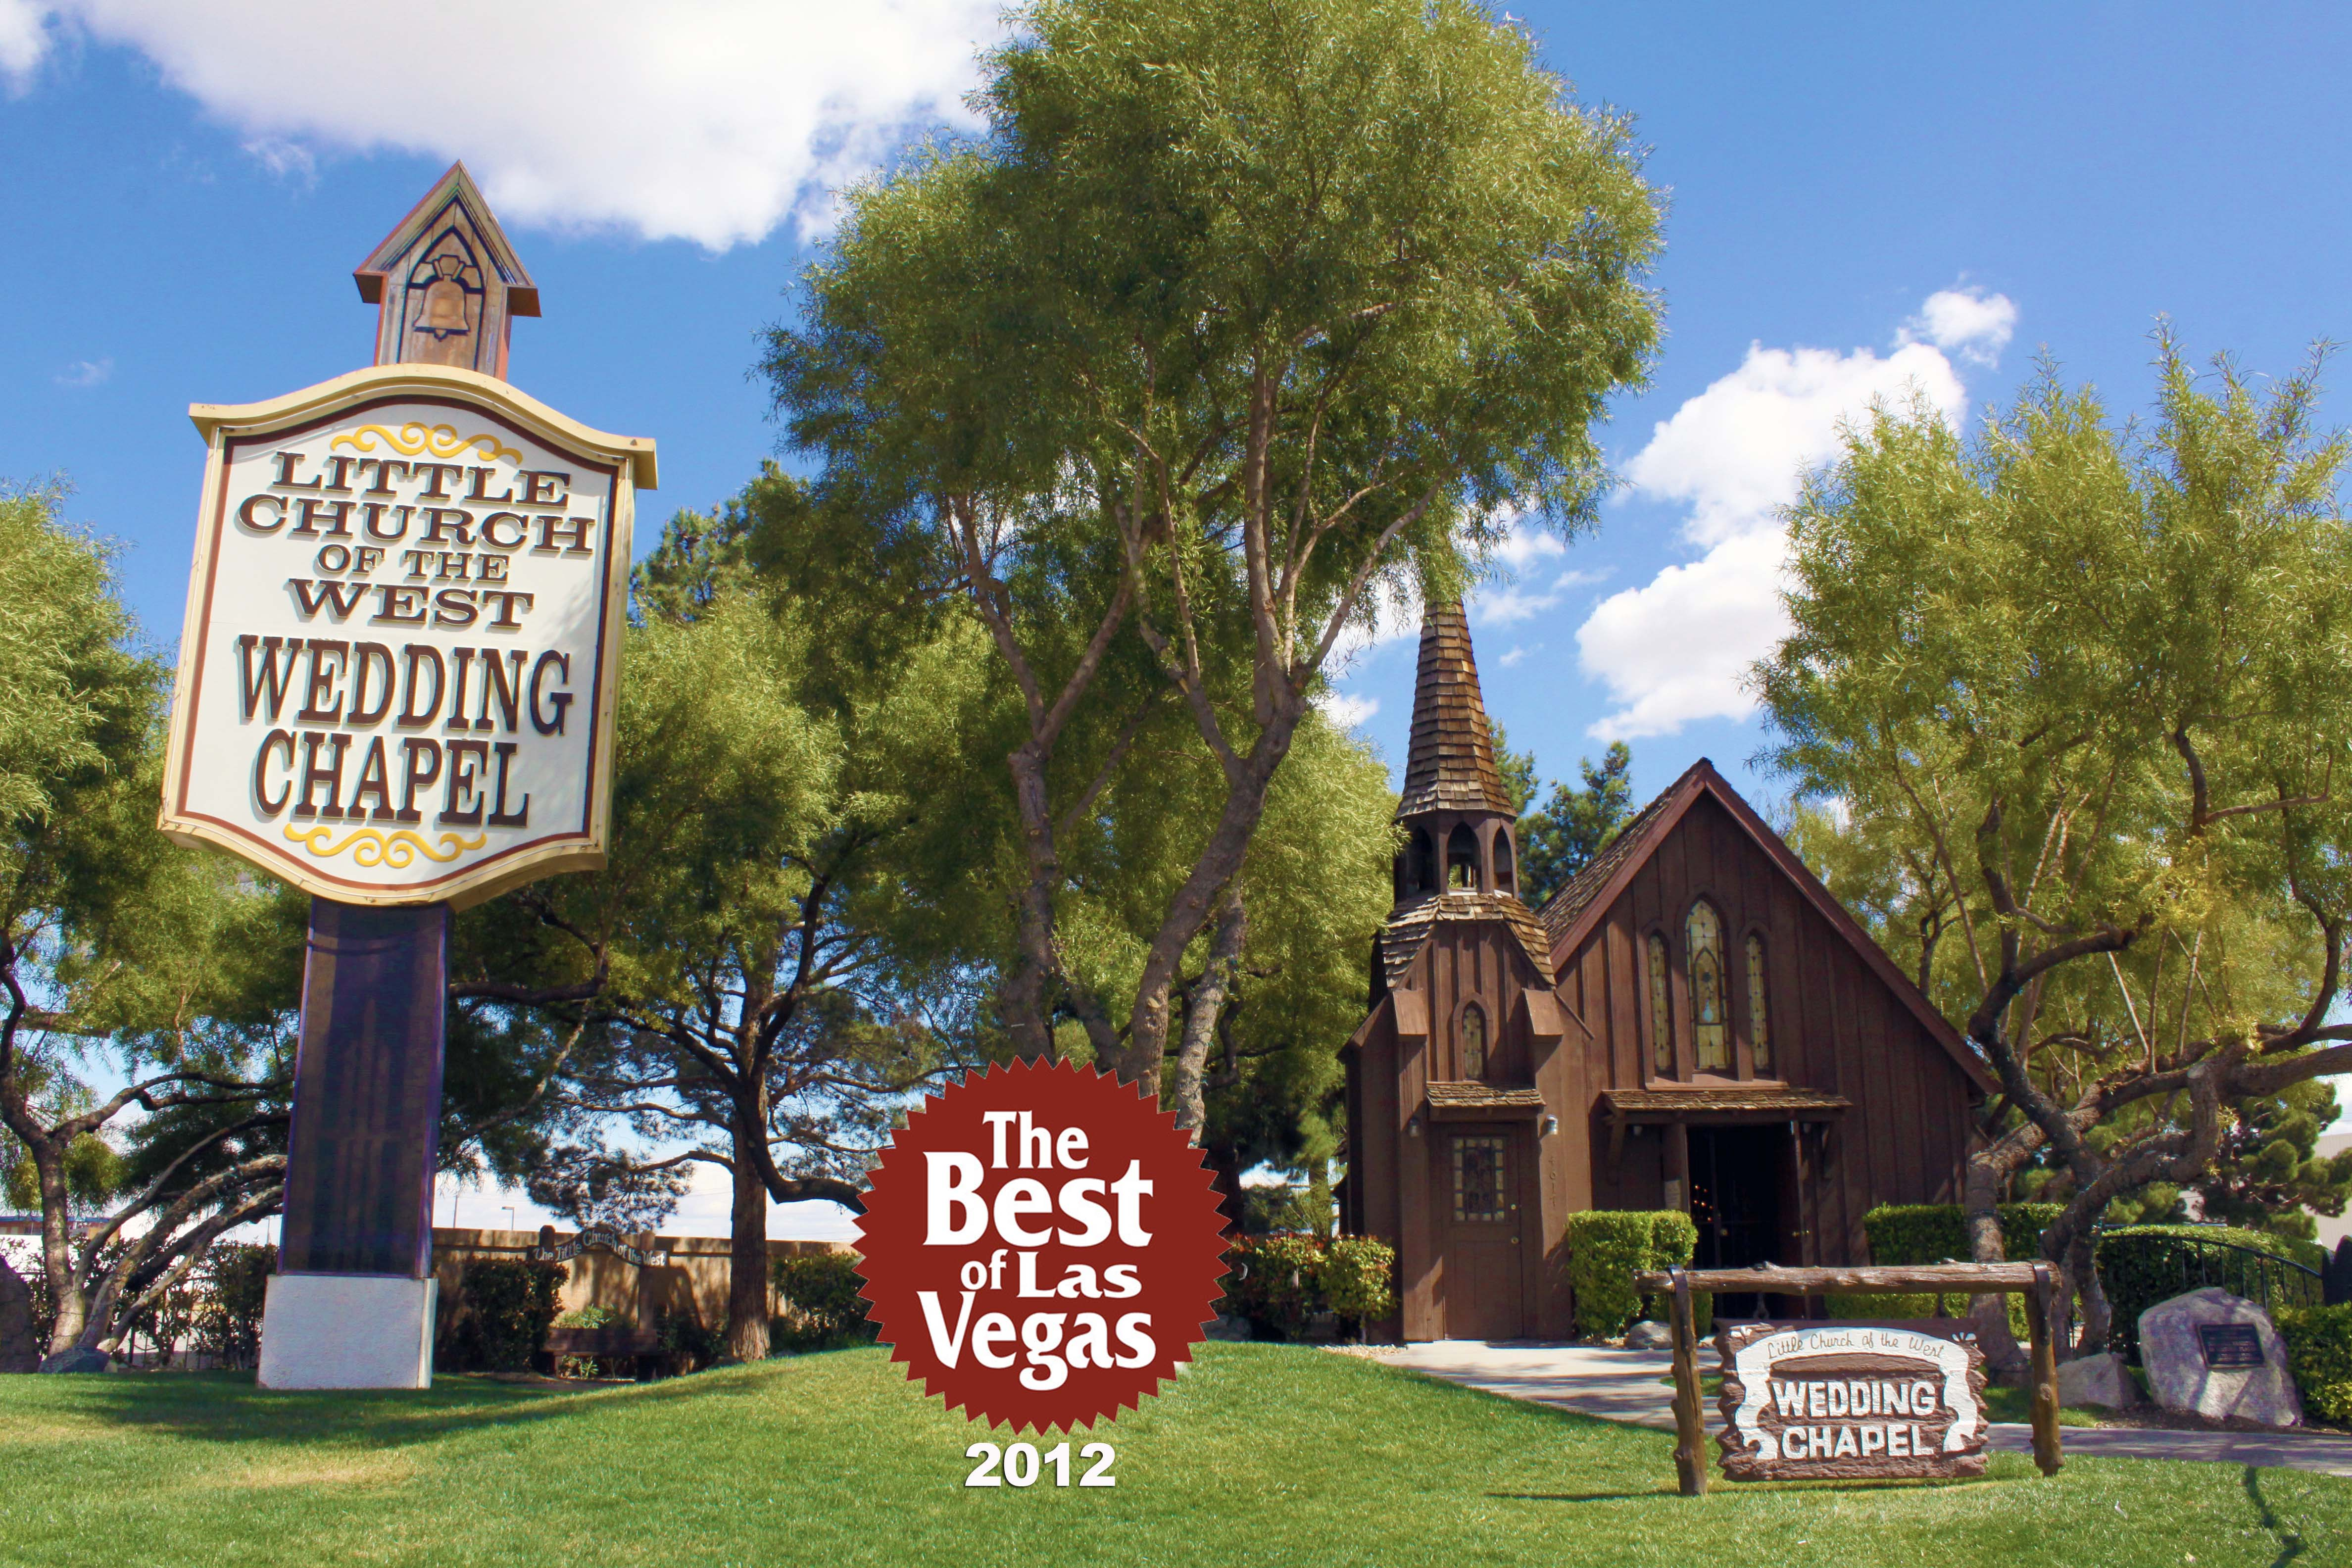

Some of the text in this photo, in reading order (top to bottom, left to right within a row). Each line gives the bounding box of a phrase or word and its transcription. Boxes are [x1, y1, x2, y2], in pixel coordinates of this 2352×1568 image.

[273, 451, 572, 508] LITTLE
[238, 494, 595, 554] CHURCH
[317, 544, 510, 583] OF THE
[289, 578, 535, 630] WEST
[238, 634, 573, 736] WEDDING
[253, 728, 530, 827] CHAPEL
[583, 1230, 617, 1253] Church
[617, 1244, 628, 1259] of
[628, 1248, 642, 1265] the
[642, 1250, 666, 1266] West
[1767, 1332, 1945, 1359] Little Church of the West
[1772, 1381, 1936, 1417] WEDDING
[1782, 1424, 1934, 1460] CHAPEL
